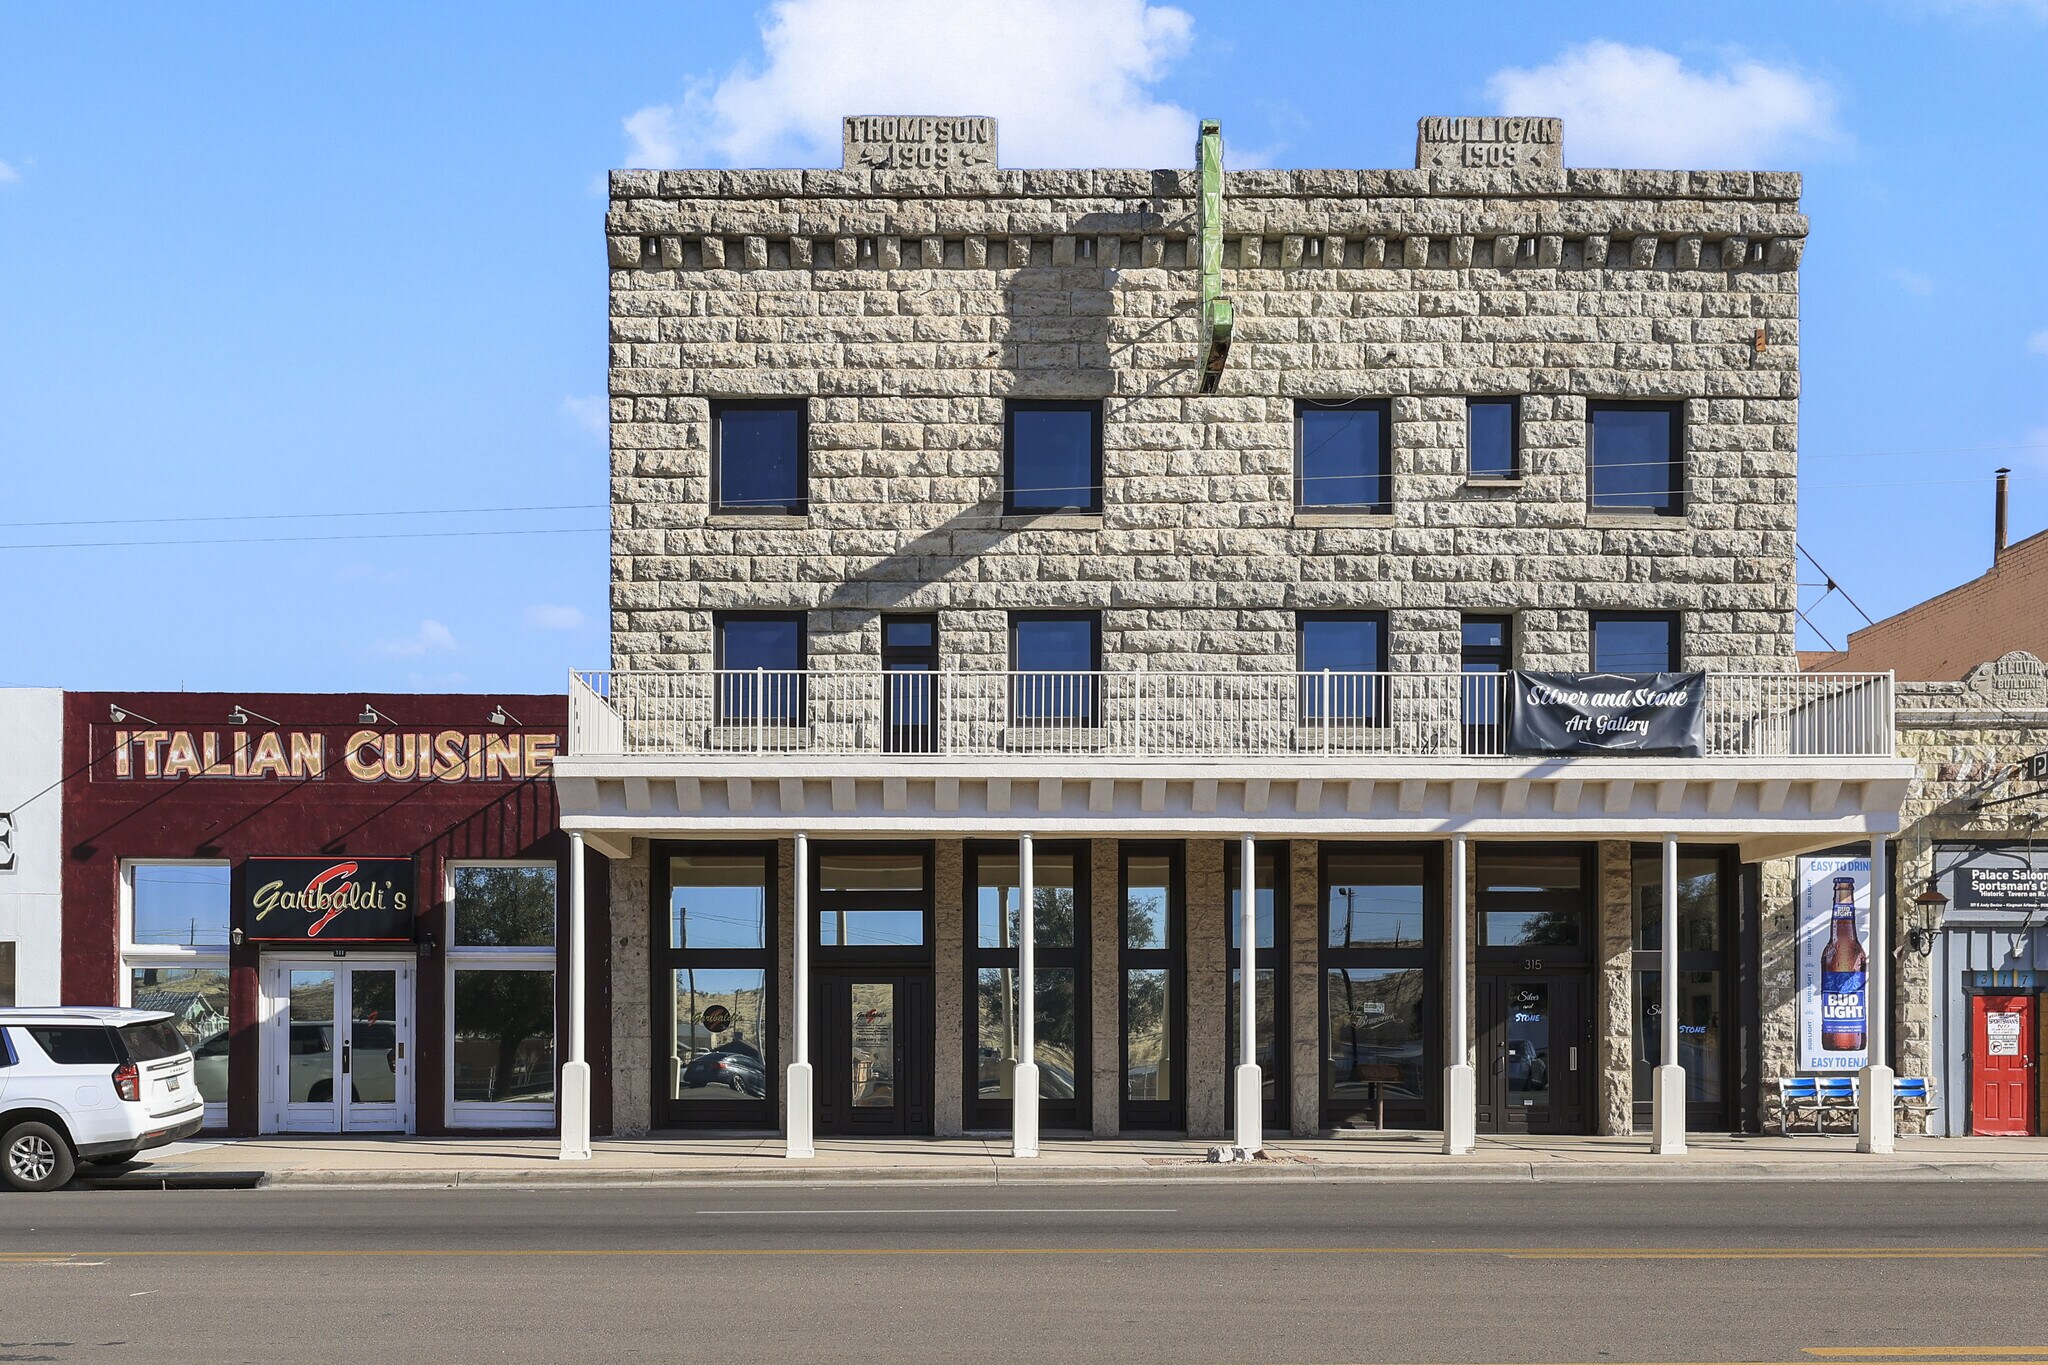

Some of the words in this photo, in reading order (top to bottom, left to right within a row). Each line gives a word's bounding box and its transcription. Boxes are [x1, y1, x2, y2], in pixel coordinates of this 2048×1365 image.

[847, 116, 989, 143] THOMPSON
[1425, 118, 1556, 144] MULLICAN
[889, 143, 951, 170] 1909
[1461, 143, 1519, 168] 1909
[1996, 678, 2042, 690] BUILDING
[1527, 686, 1589, 708] Silver
[1590, 688, 1631, 708] and
[1632, 686, 1689, 708] Stone
[1565, 715, 1593, 733] Art
[1596, 714, 1650, 737] Gallery
[116, 731, 324, 779] ITALIAN
[345, 730, 559, 781] CUISINE
[1811, 861, 1832, 871] EASY
[1835, 861, 1846, 871] TO
[1972, 870, 2009, 880] Palace
[1972, 881, 2037, 892] Sportsman's
[253, 880, 407, 921] Garibaldi's
[1524, 959, 1542, 970] 315
[1517, 991, 1539, 1002] Silver
[1828, 994, 1858, 1006] BUD
[1515, 1013, 1540, 1022] STONE
[1824, 1006, 1863, 1018] LIGHT
[1679, 1025, 1706, 1033] STONE
[1812, 1057, 1833, 1067] EASY
[1835, 1057, 1846, 1067] TO
